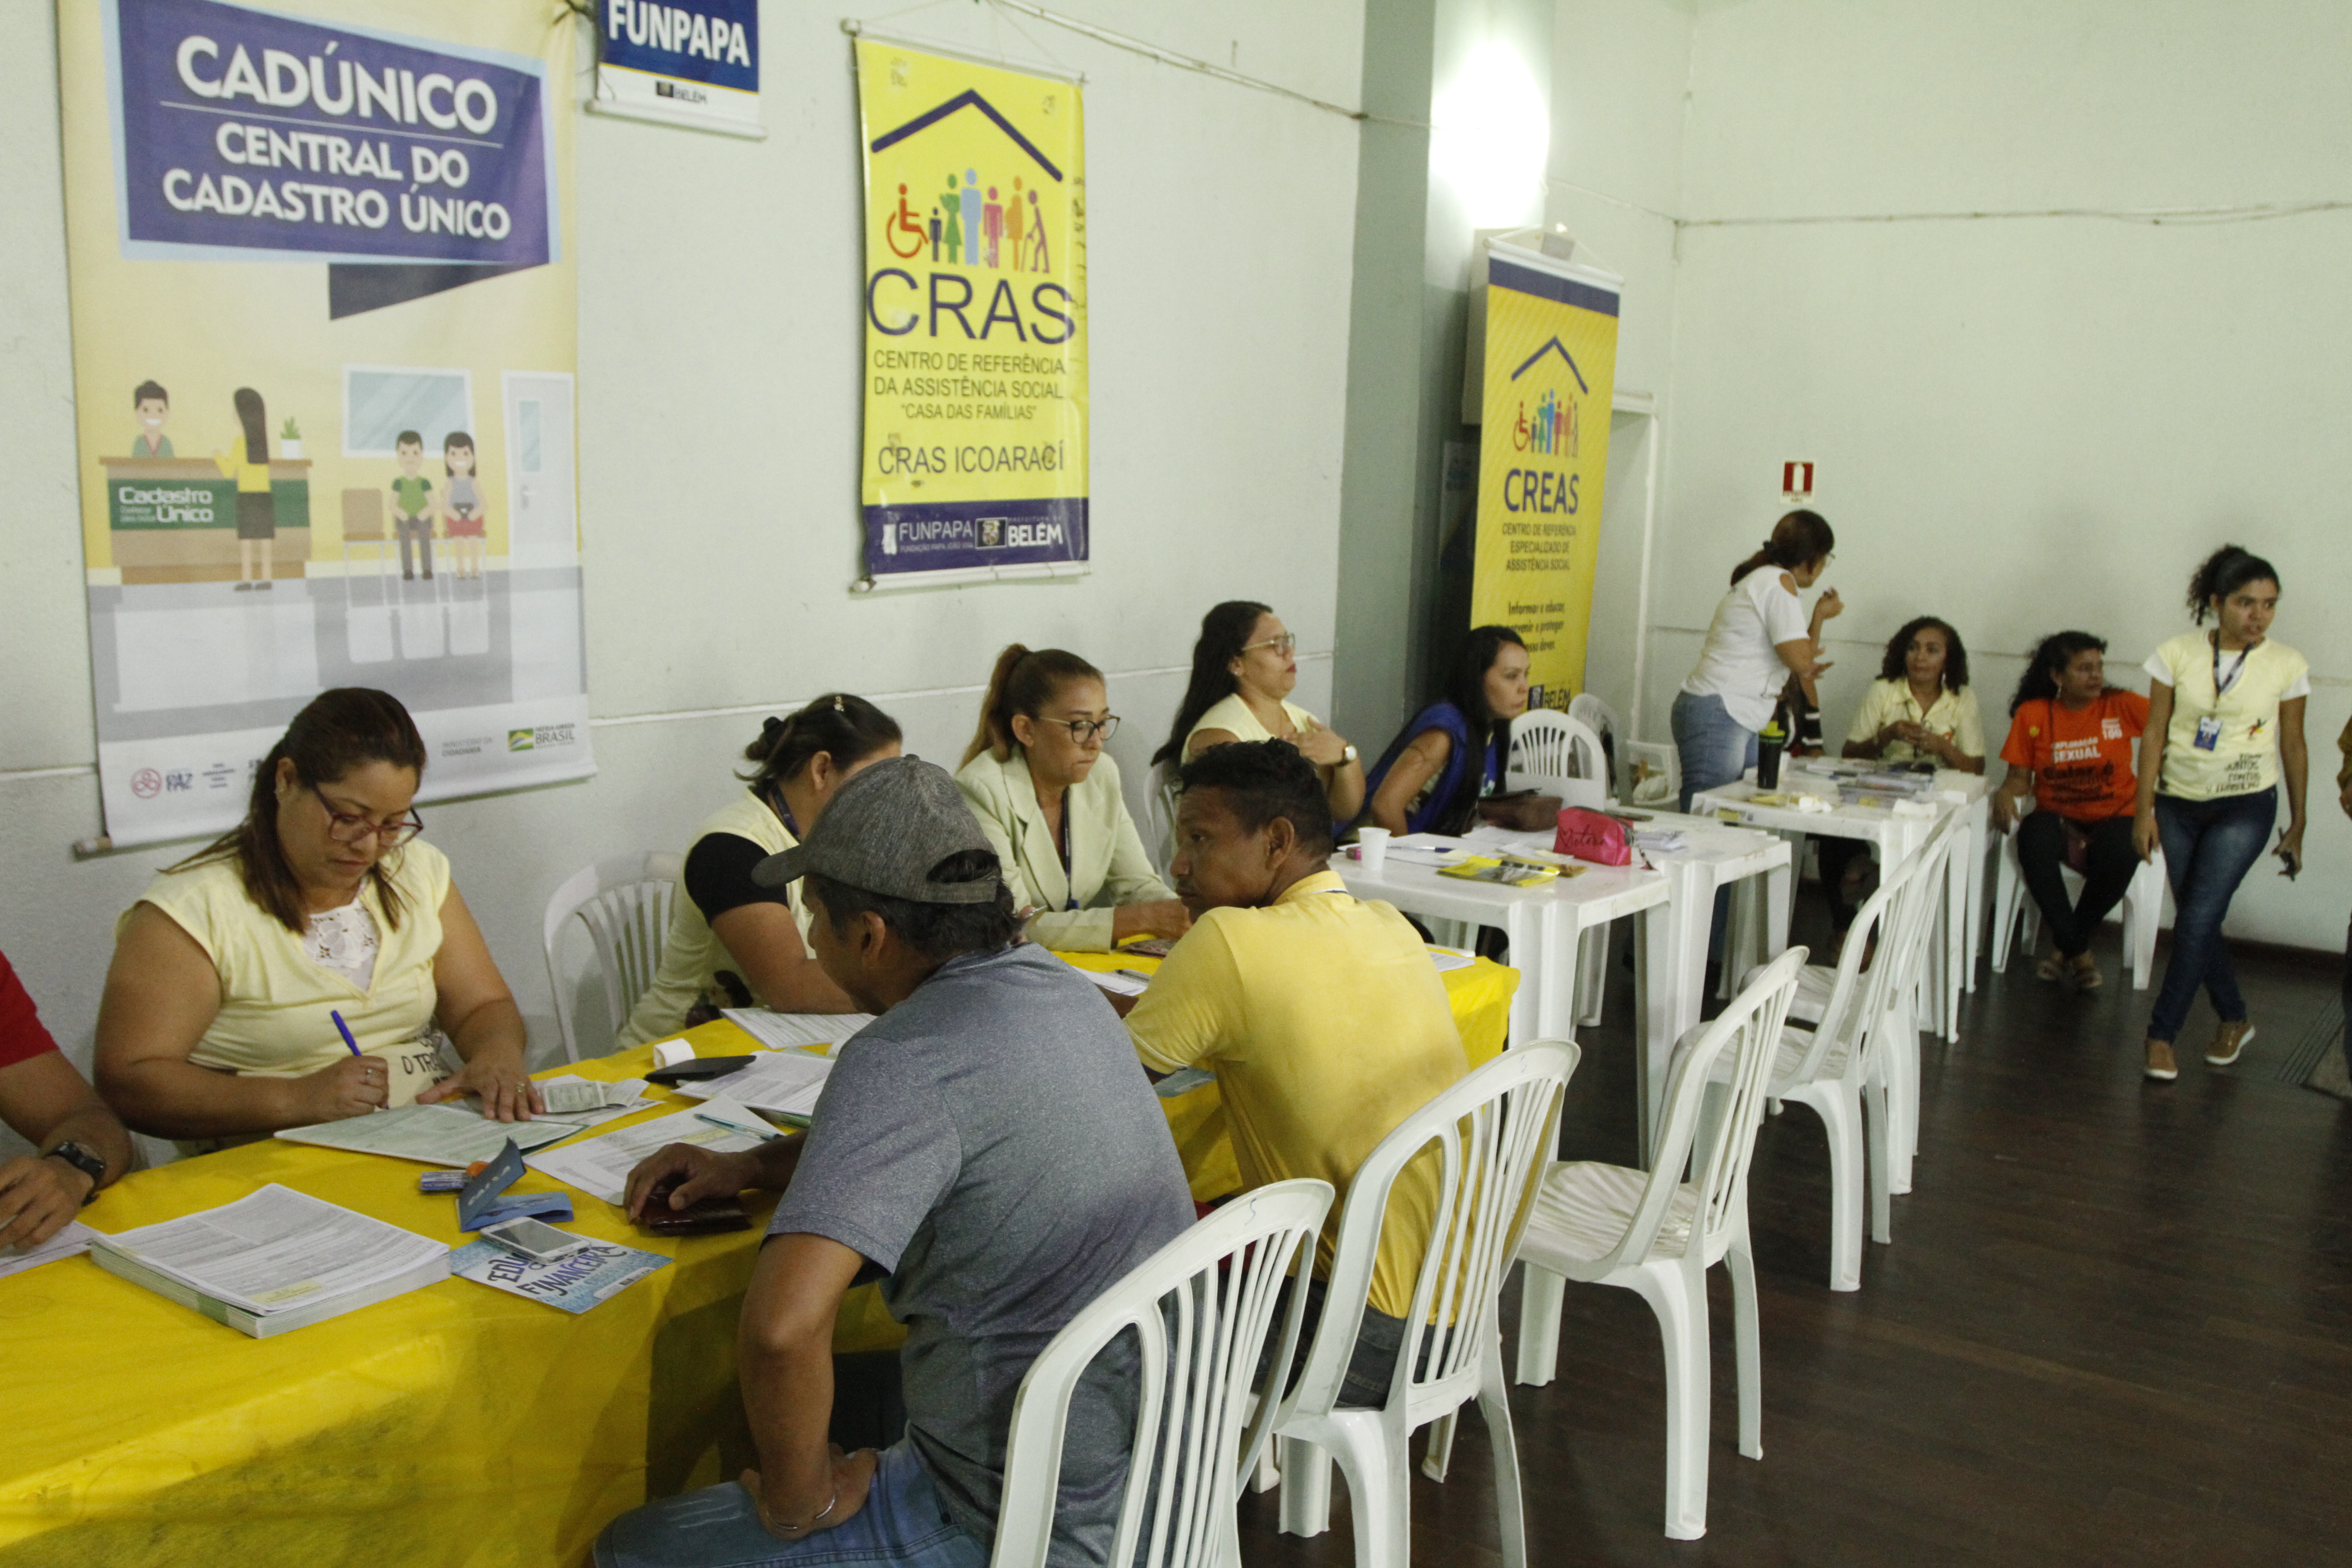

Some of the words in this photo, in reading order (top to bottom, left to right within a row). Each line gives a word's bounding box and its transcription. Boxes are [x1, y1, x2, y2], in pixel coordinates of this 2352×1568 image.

[608, 0, 751, 67] FUNPAPA
[176, 35, 498, 135] CADÚNICO
[216, 122, 402, 181] CENTRAL
[412, 146, 469, 188] DO
[163, 168, 389, 230] CADASTRO
[401, 184, 511, 240] ÚNICO
[867, 267, 1076, 344] CRAS
[874, 349, 943, 370] CENTRO
[947, 353, 967, 371] DE
[973, 353, 1065, 374] REFERÊNCIA
[874, 376, 897, 396] DA
[902, 376, 1007, 398] ASSISTÊNCIA
[1012, 380, 1063, 399] SOCIAL
[946, 403, 973, 420] DAS
[878, 446, 947, 474] CRAS
[118, 486, 213, 505] Cadastro
[1504, 468, 1580, 515] CREAS
[156, 504, 214, 522] Único
[899, 520, 974, 541] FUNPAPA
[1008, 522, 1063, 547] BELÉM
[536, 730, 575, 744] BRASIL
[515, 1246, 628, 1297] FINANCEIRA
